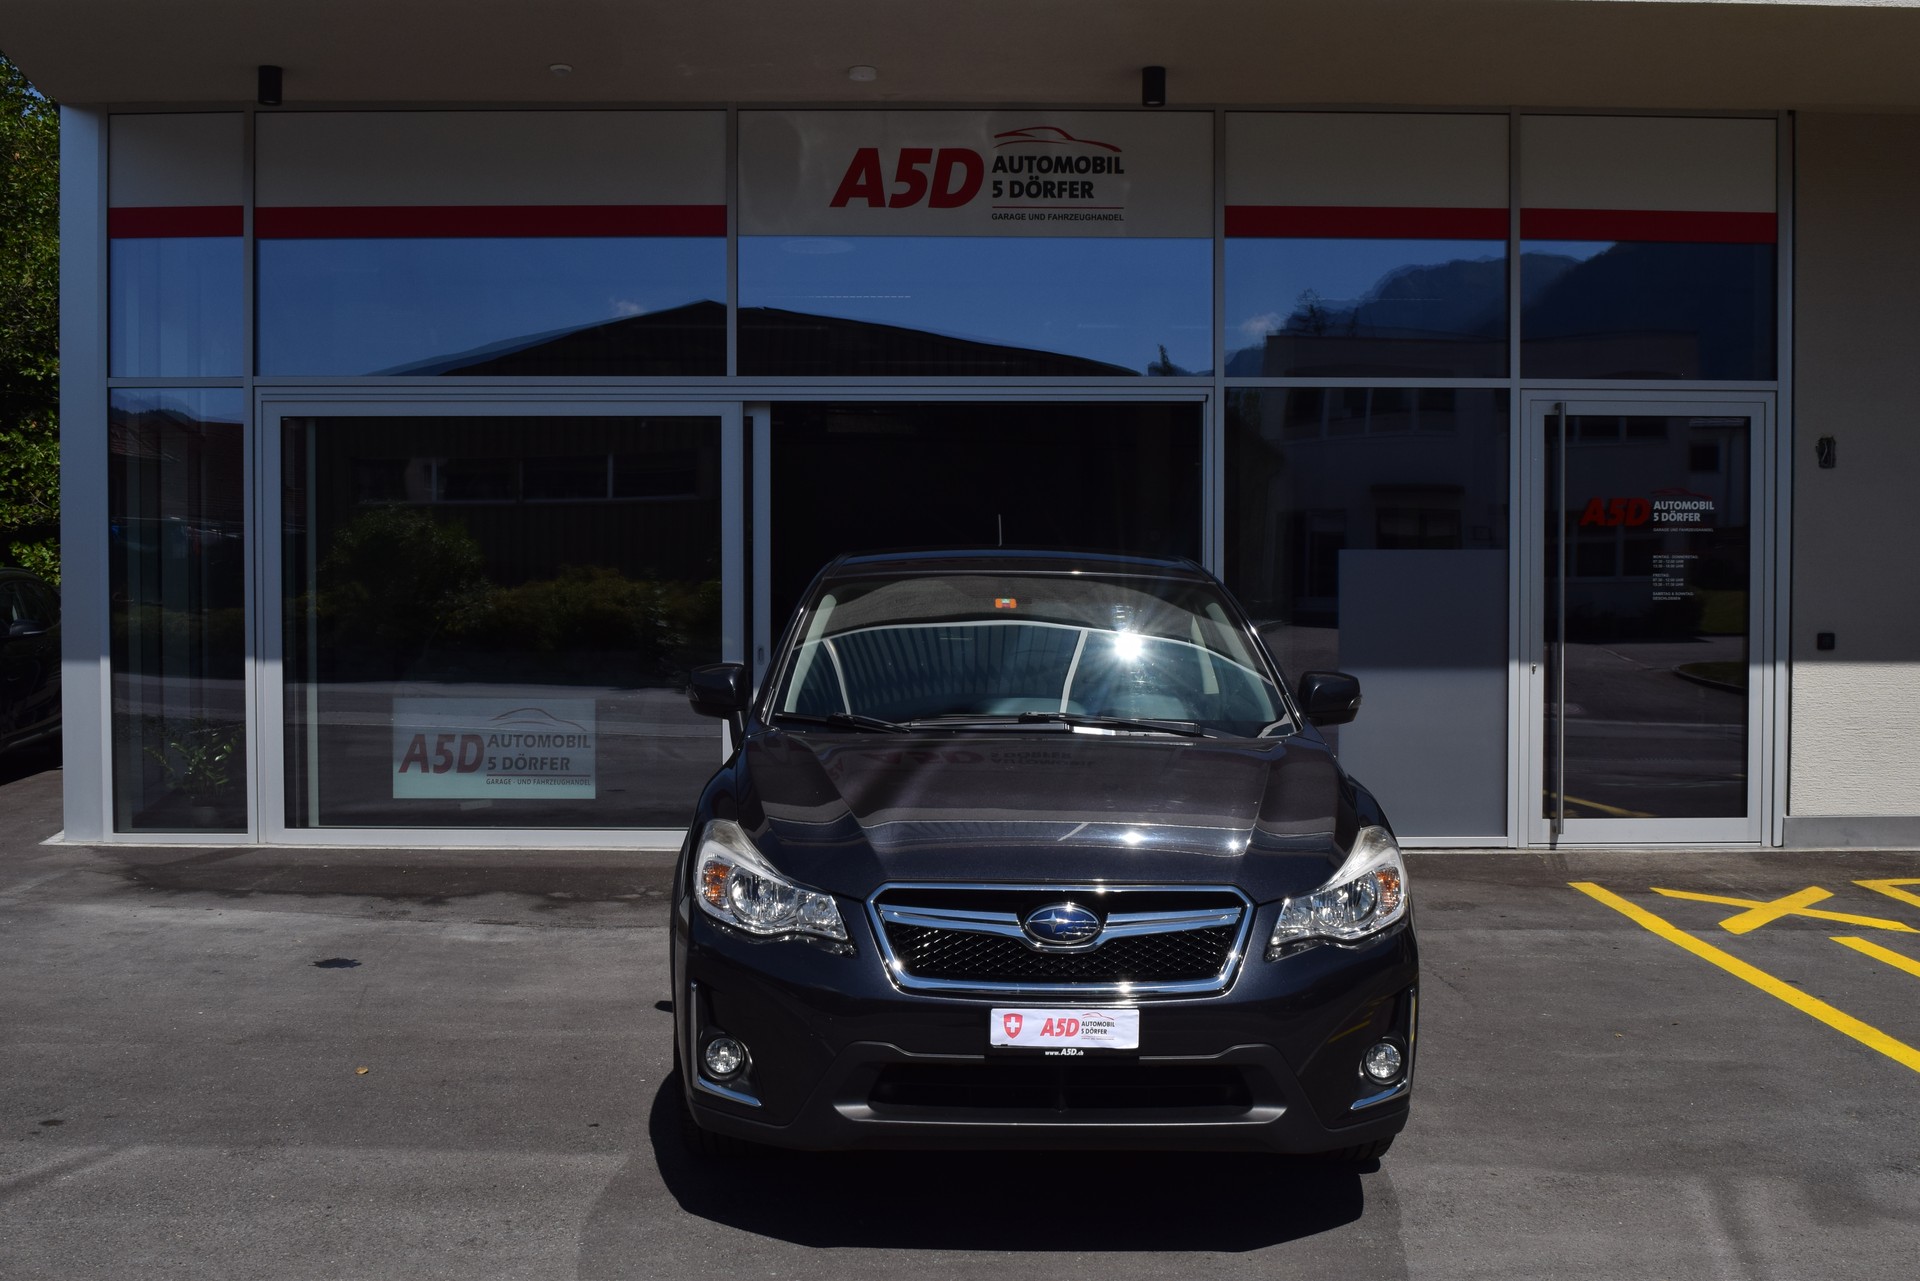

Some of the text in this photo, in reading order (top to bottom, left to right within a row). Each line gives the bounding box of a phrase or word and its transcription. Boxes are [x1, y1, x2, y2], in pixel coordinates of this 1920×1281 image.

[992, 156, 1125, 174] AUTOMOBIL
[829, 147, 985, 208] A5D
[992, 175, 1095, 199] 5 DÖRFER
[991, 213, 1125, 222] GARAGE UND FAHRZEUGHANDEL
[1578, 496, 1650, 527] A5D
[1653, 501, 1715, 510] AUTOMOBIL
[1653, 510, 1701, 522] 5 DÖRFER
[487, 734, 591, 749] AUTOMOBIL
[398, 733, 485, 774] A5D
[487, 753, 570, 771] 5 DÖRFER
[533, 778, 591, 786] FAHRZEUGHANDEL
[1040, 1018, 1080, 1037] A5D
[1085, 1027, 1108, 1035] DÖRFER
[1045, 1048, 1084, 1056] www.A5D.ch
